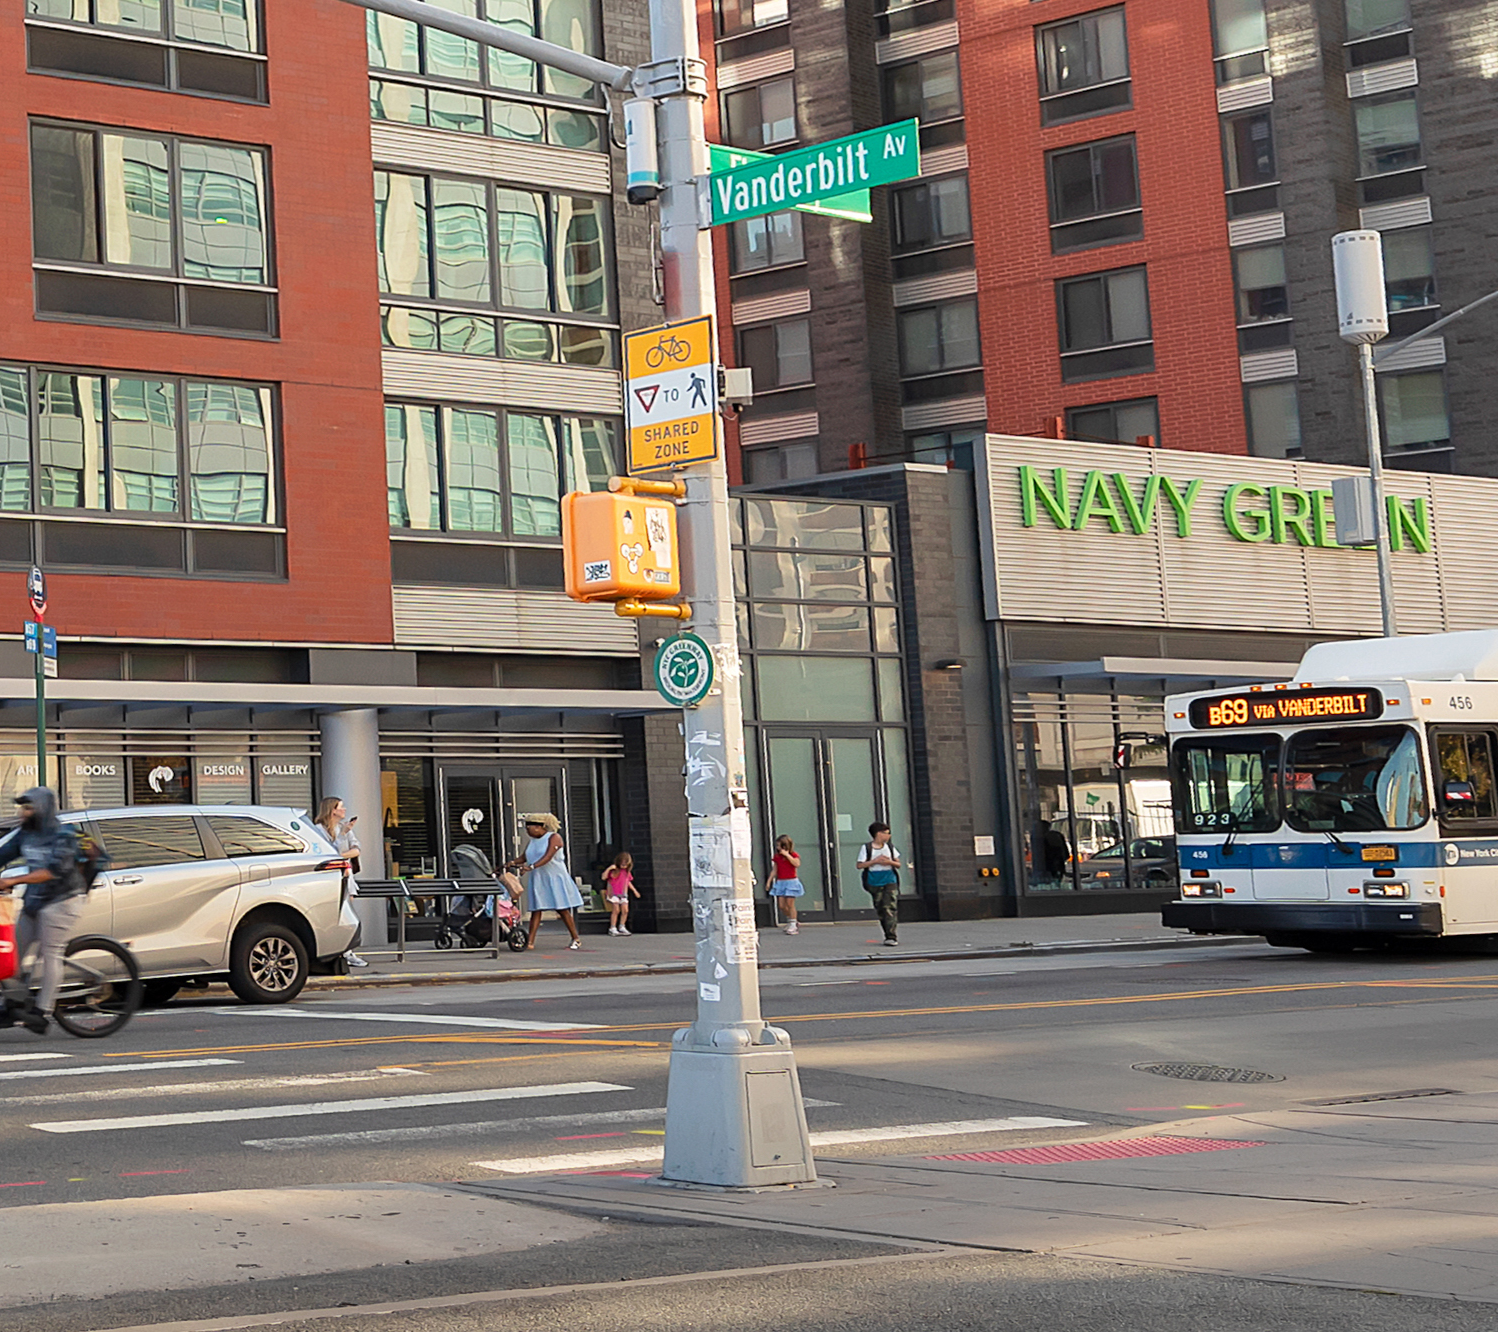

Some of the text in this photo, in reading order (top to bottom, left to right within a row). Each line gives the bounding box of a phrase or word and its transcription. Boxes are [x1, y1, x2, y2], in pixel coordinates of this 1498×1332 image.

[717, 133, 906, 214] Vanderbilt Av
[663, 388, 679, 403] TO
[644, 421, 699, 443] SHARED
[655, 441, 689, 459] ZONE
[1019, 465, 1431, 554] NAVY GREN
[669, 643, 704, 660] GREENWAY
[1209, 694, 1367, 726] B69 VIA VANDERBILT
[1449, 695, 1473, 710] 456
[75, 765, 116, 776] BOOKS
[204, 765, 244, 776] DESIGN
[262, 764, 309, 775] GALLERY
